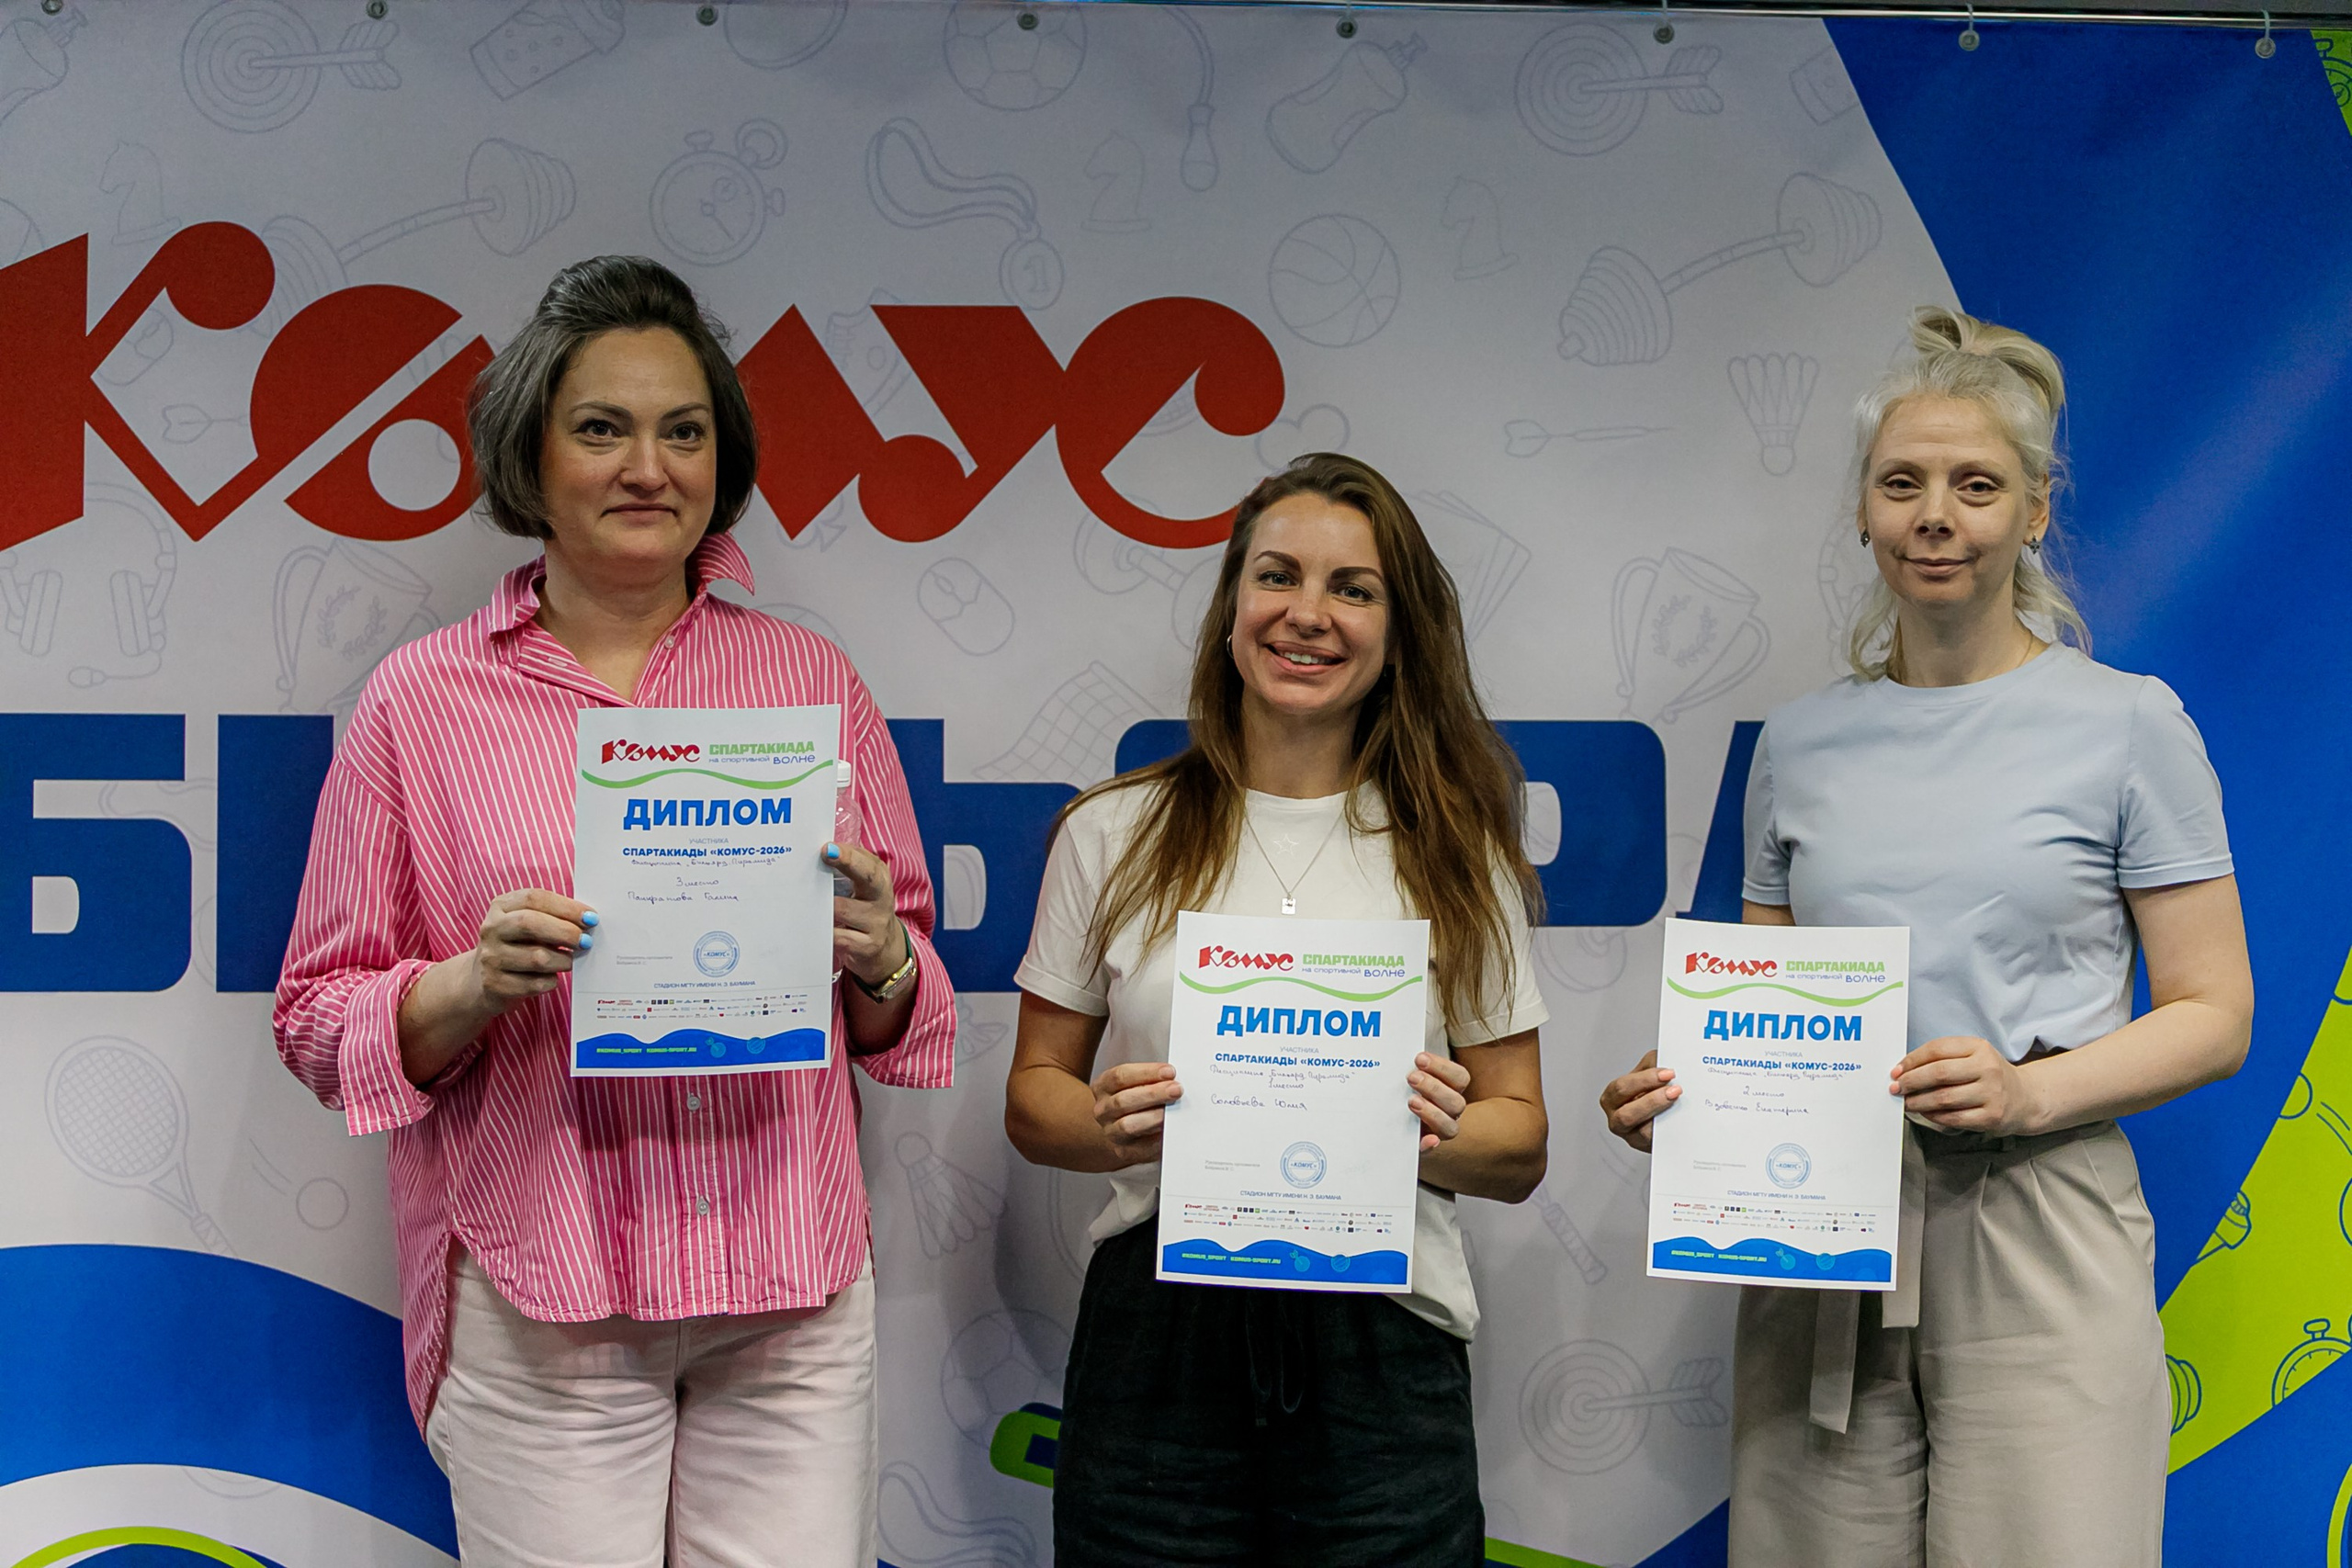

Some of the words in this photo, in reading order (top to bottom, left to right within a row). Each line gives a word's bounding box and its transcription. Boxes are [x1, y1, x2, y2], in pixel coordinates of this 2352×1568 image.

[709, 741, 815, 755] СПАРТАКИАДА
[623, 797, 792, 830] ДИПЛОМ
[622, 848, 707, 858] СПАРТАКИАДЫ
[710, 846, 792, 857] «КОМУС-2026»
[1303, 954, 1405, 966] СПАРТАКИАДА
[1786, 960, 1885, 972] СПАРТАКИАДА
[1216, 1005, 1381, 1037] ДИПЛОМ
[1703, 1010, 1862, 1041] ДИПЛОМ
[1215, 1053, 1297, 1066] СПАРТАКИАДЫ
[1300, 1058, 1381, 1067] «КОМУС-2026»
[1702, 1056, 1781, 1069] СПАРТАКИАДЫ
[1785, 1062, 1862, 1071] «КОМУС-2026»
